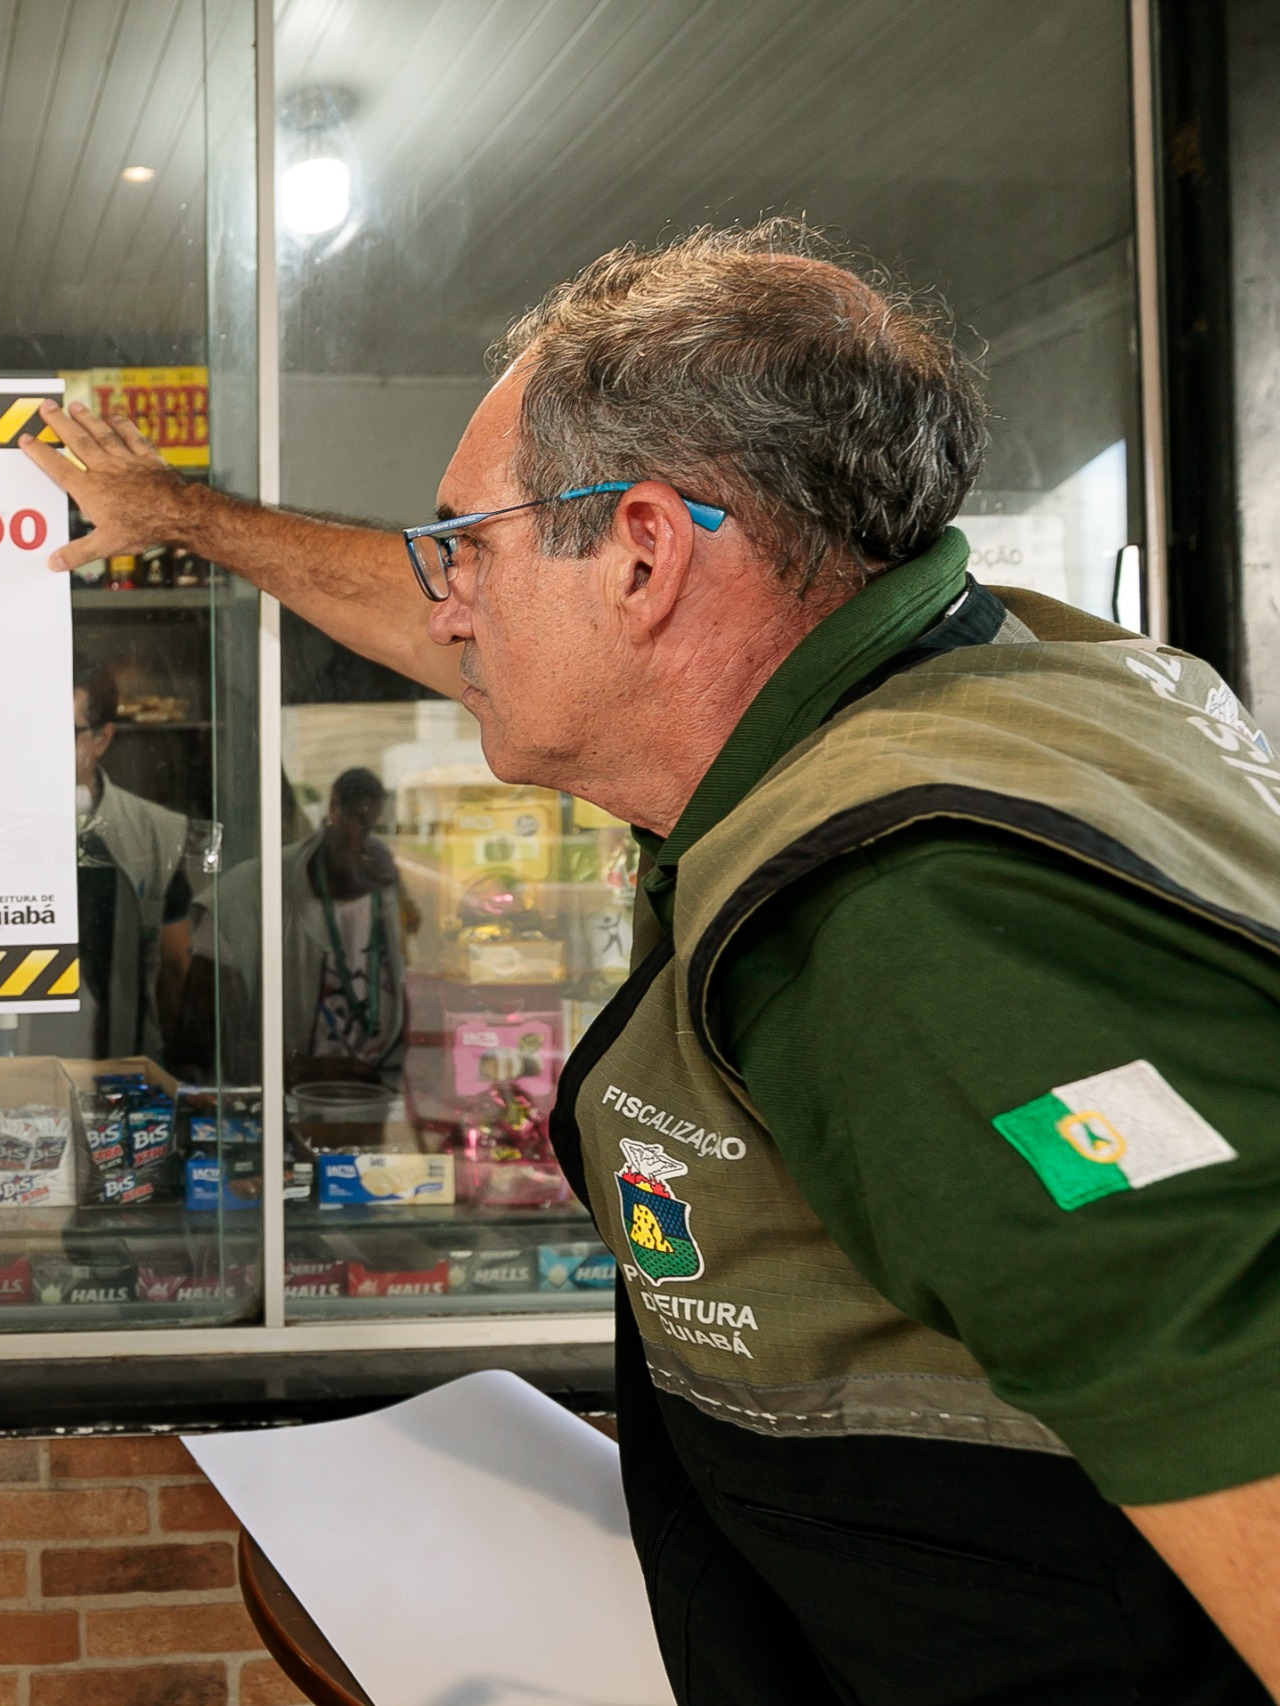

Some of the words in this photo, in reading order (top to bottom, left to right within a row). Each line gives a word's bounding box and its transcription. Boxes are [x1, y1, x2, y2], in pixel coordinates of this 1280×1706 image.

[970, 545, 1022, 568] OÇÃO
[41, 894, 54, 902] DE
[475, 1267, 530, 1282] HALLS
[71, 1287, 128, 1302] HALLS
[178, 1286, 235, 1301] HALLS
[284, 1283, 340, 1297] HALLS
[386, 1282, 443, 1296] HALLS
[659, 1314, 754, 1359] CUIABÁ
